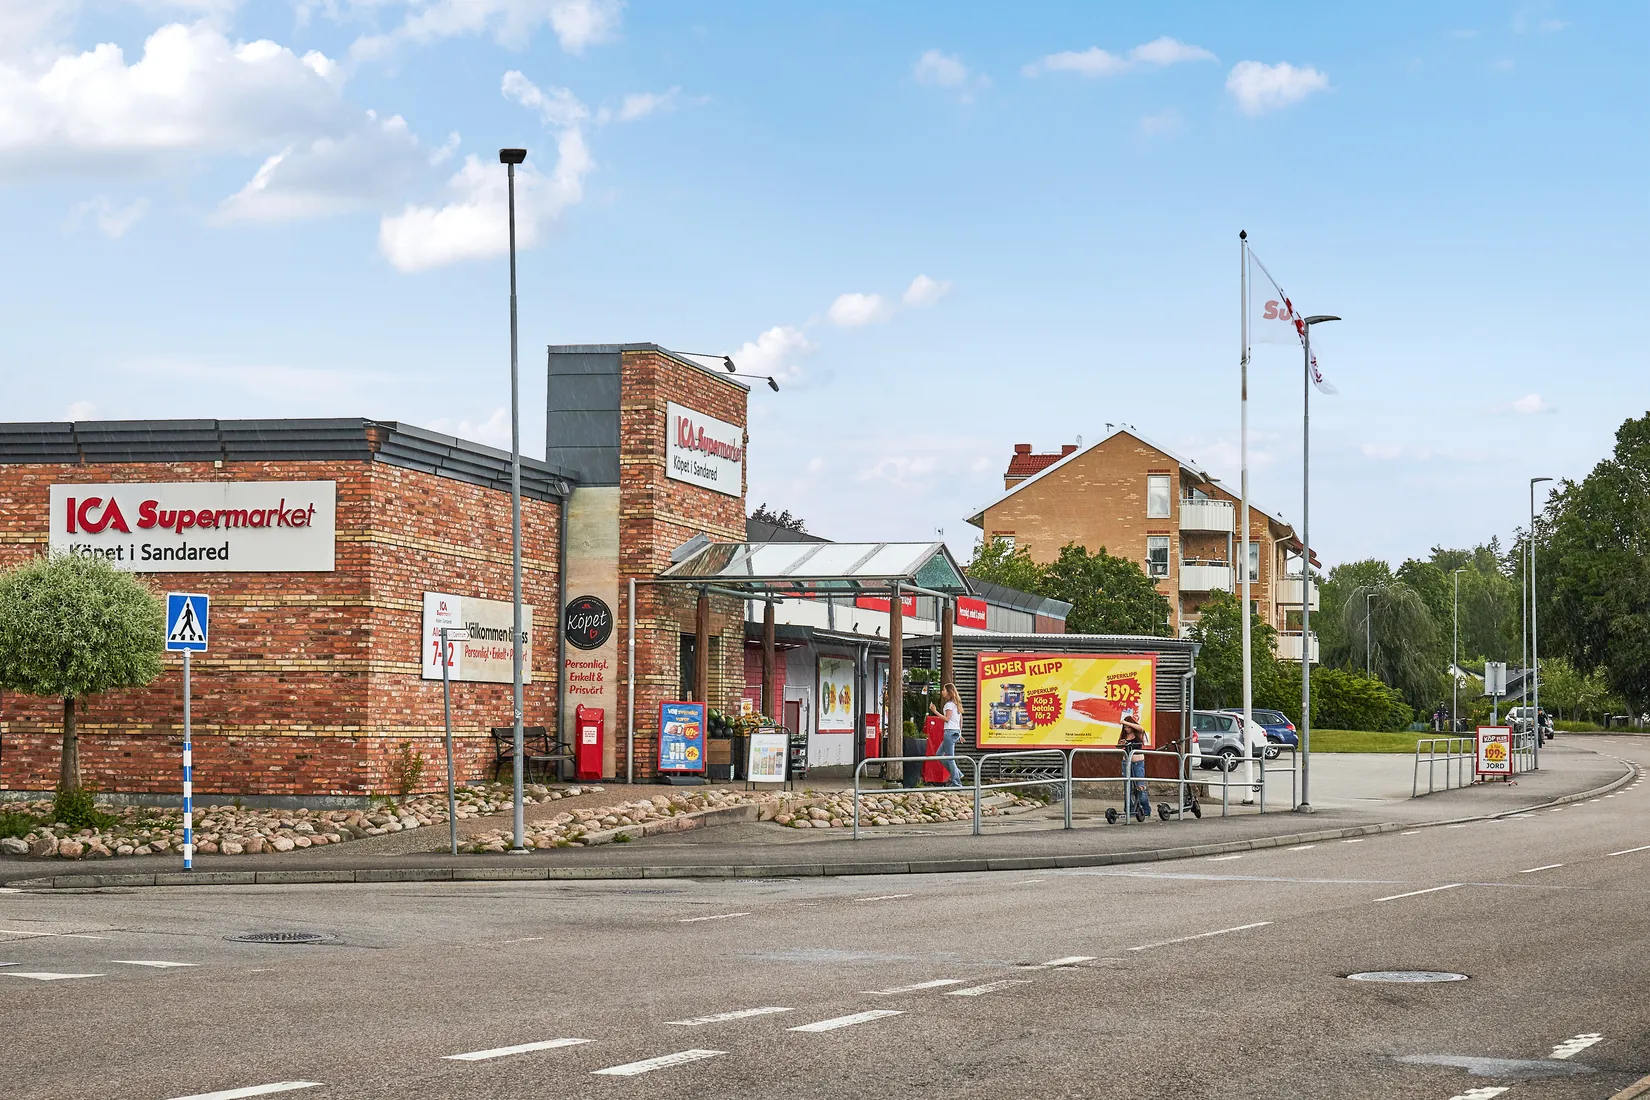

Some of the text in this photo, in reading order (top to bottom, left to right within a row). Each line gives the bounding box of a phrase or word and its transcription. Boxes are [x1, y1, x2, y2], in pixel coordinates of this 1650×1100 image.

[1263, 300, 1295, 325] Su
[677, 416, 697, 450] ICA
[673, 455, 689, 475] Köpet
[694, 461, 718, 481] Sandared
[67, 497, 316, 534] ICA Supermarket
[130, 544, 134, 560] i
[141, 541, 229, 560] Sandared
[567, 611, 607, 634] Köpet
[432, 641, 454, 666] 7-2
[565, 659, 608, 670] Personligt,
[984, 661, 1063, 676] SUPER KLIPP
[570, 672, 603, 682] Enkelt &
[1107, 671, 1138, 680] SUPERKLIPP
[570, 684, 603, 694] Prisvärt
[1027, 687, 1059, 696] SUPERKLIPP
[1107, 684, 1139, 701] 139:-
[1033, 697, 1048, 705] Köp
[1485, 749, 1506, 758] 199:-
